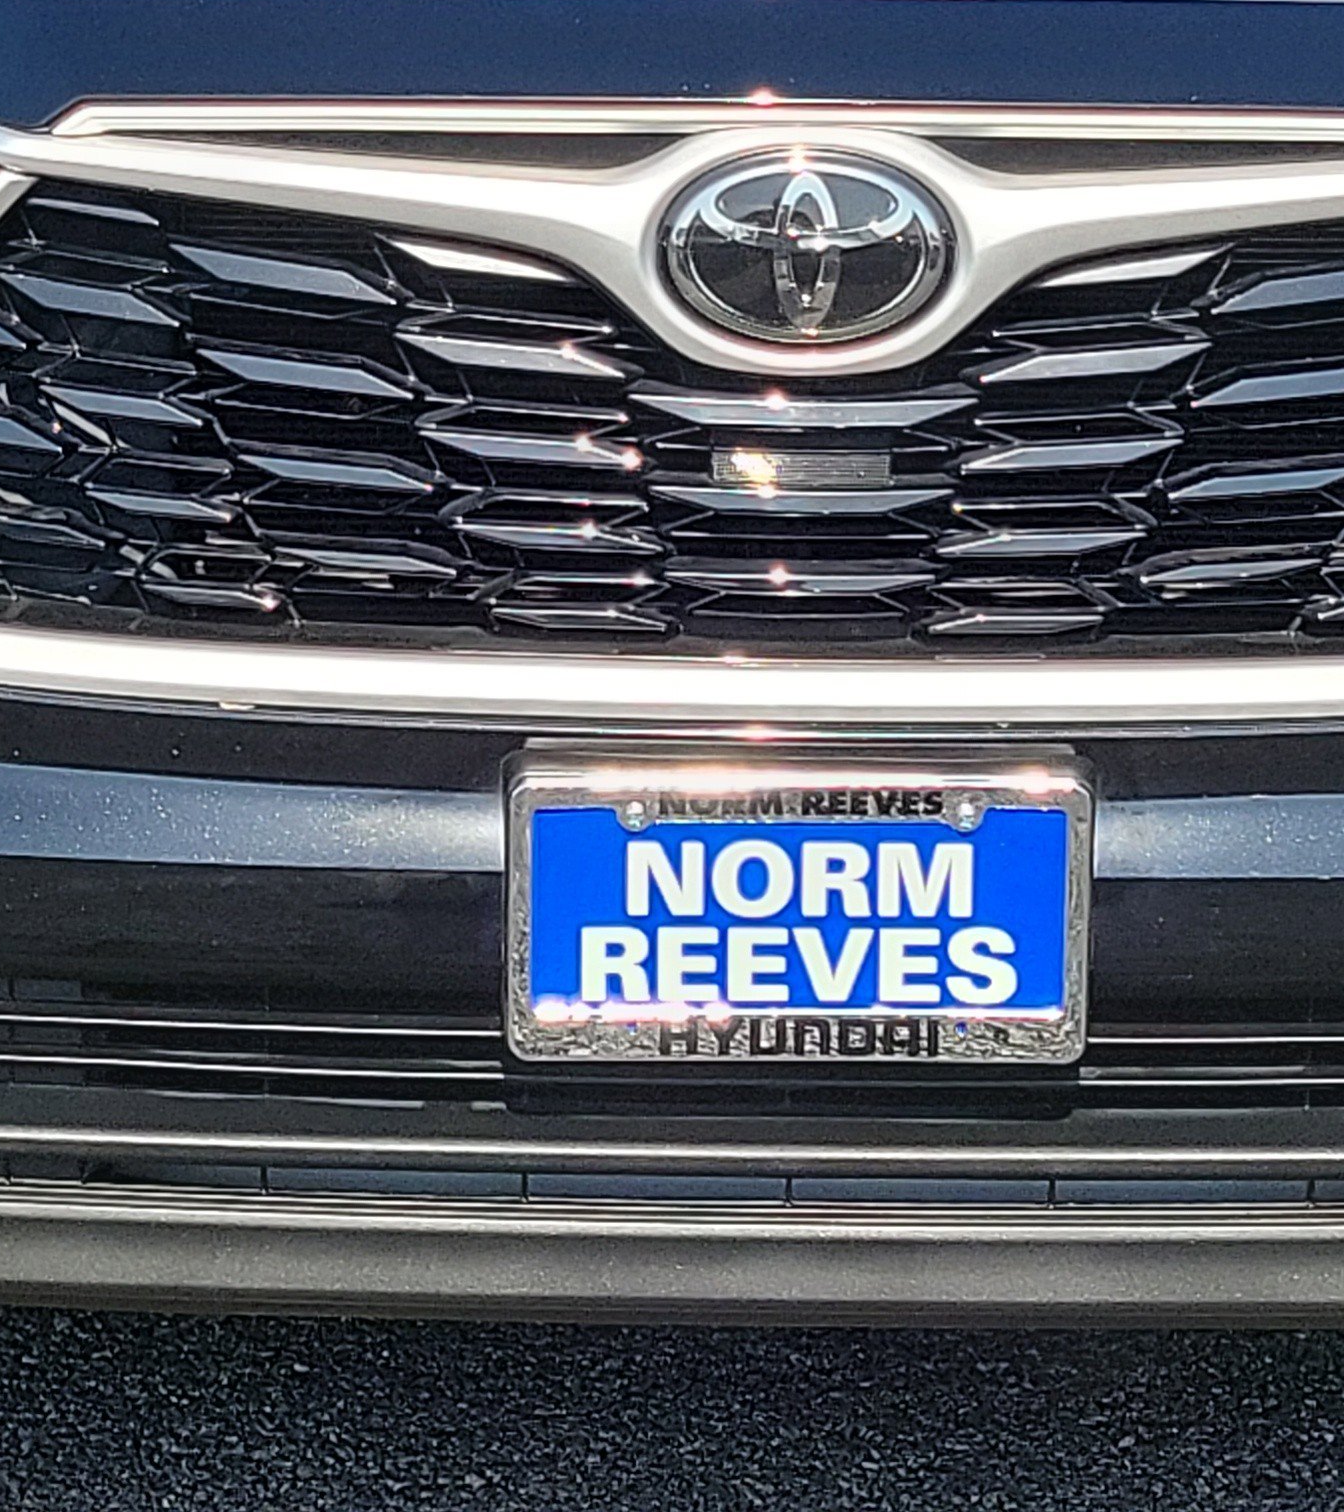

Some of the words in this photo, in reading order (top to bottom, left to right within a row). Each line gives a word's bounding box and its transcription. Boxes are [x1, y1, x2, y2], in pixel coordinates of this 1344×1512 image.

[658, 790, 784, 816] NORM
[800, 790, 943, 816] REEVES
[625, 839, 974, 918] NORM
[579, 925, 1018, 1006] REEVES
[658, 1015, 939, 1057] HYUNDAI
